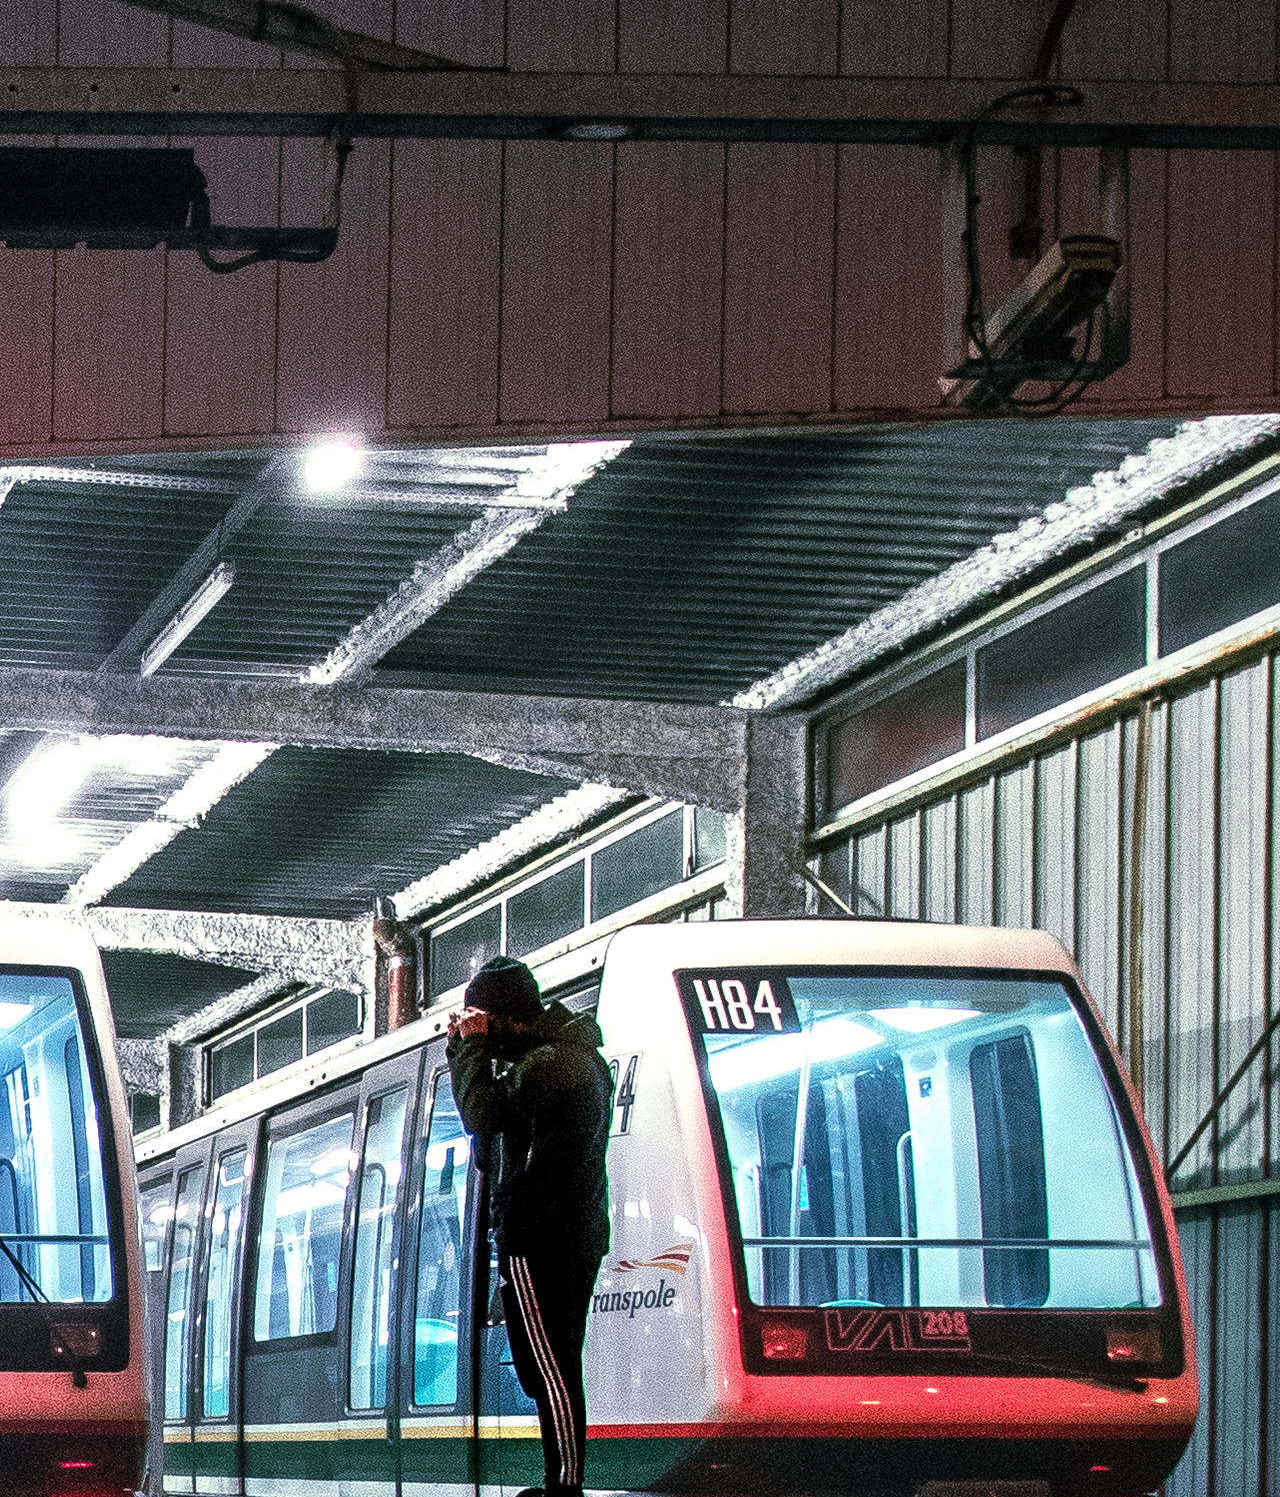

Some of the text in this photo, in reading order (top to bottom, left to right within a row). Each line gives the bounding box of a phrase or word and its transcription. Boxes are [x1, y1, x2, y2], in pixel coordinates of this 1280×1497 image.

[692, 978, 783, 1031] H84
[591, 1278, 676, 1319] ranspole
[824, 1309, 972, 1352] VAL 208
